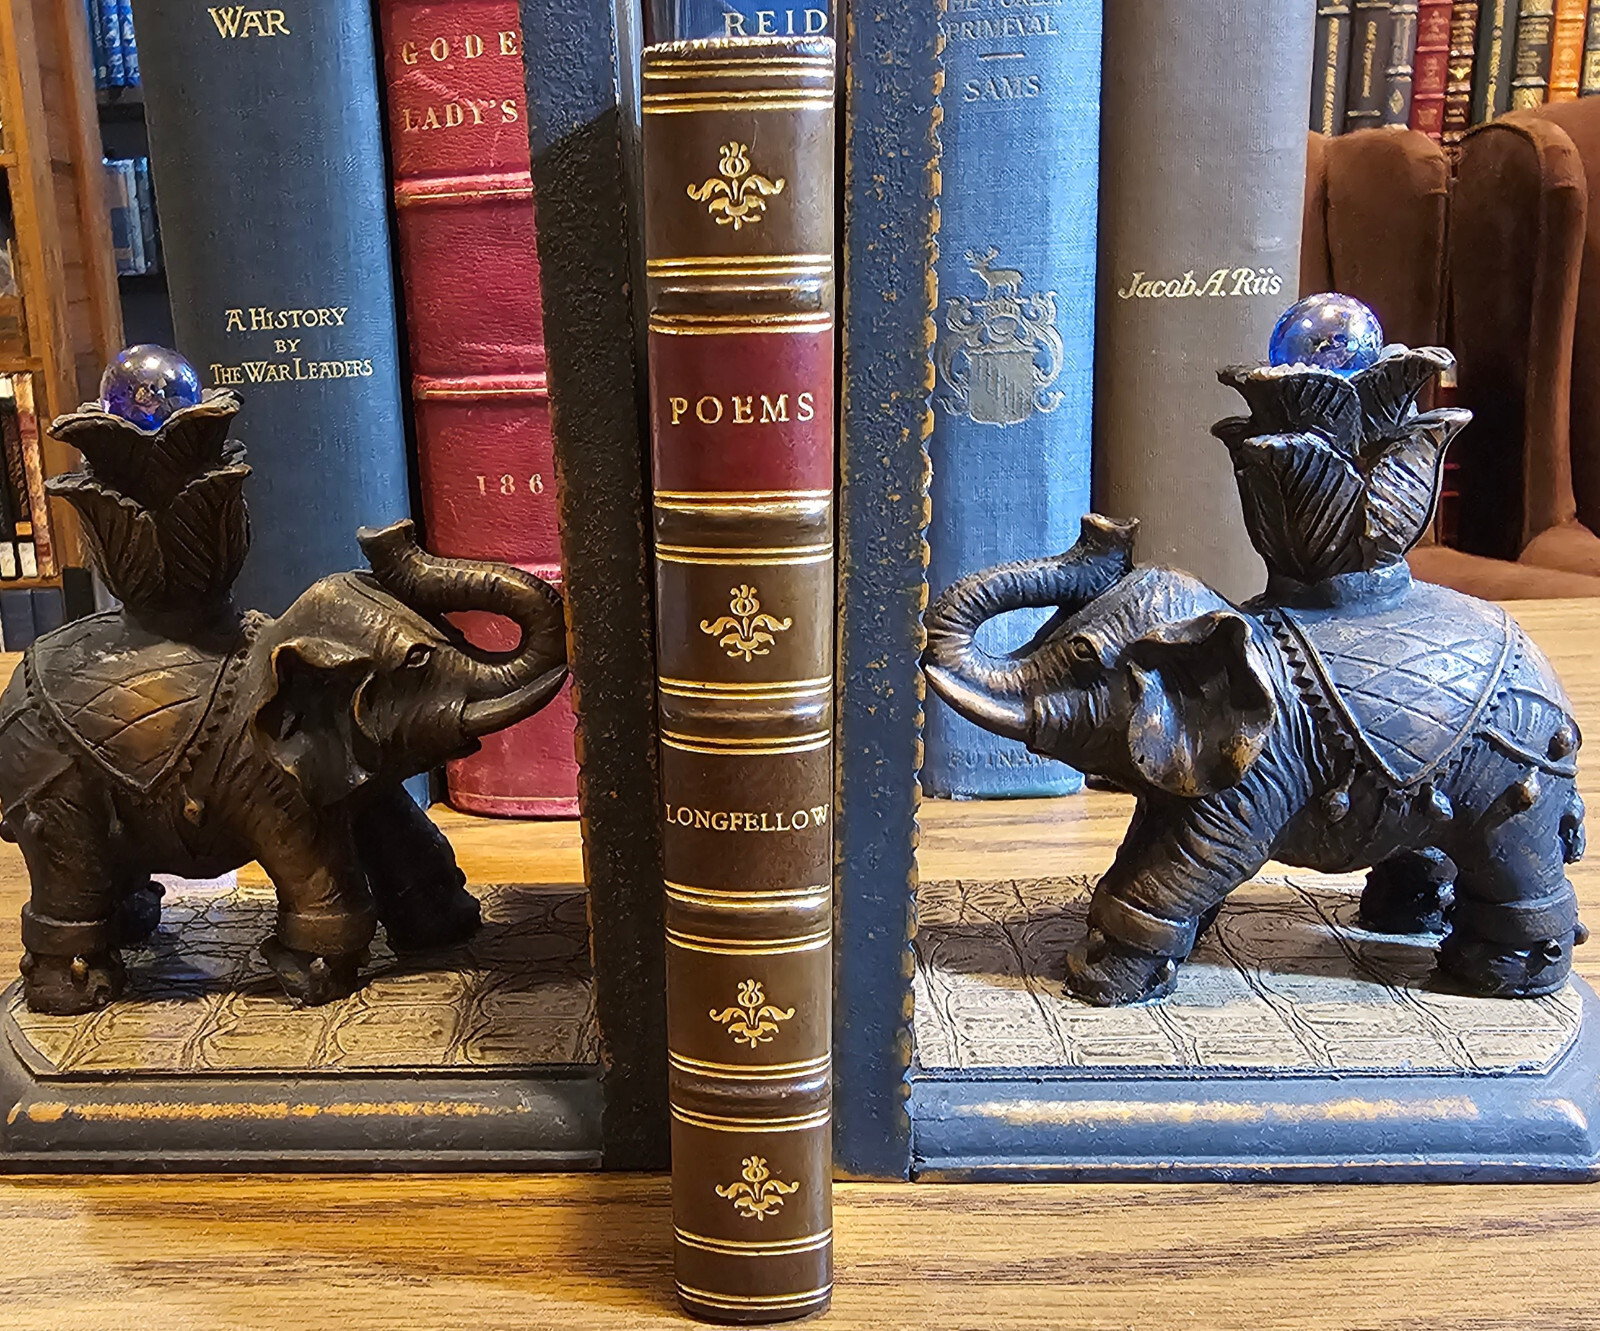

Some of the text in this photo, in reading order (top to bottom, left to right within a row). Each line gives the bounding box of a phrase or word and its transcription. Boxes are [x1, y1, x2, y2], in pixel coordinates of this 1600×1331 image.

[207, 5, 291, 39] WAR
[722, 9, 829, 37] REID
[946, 14, 1059, 42] PRIMEVAL
[401, 30, 518, 66] GODE
[963, 75, 1041, 102] SAMS
[402, 98, 519, 133] LADY'S
[1117, 266, 1284, 300] Jacob A. Riis
[225, 306, 349, 333] A HISTORY
[274, 338, 301, 353] BY
[209, 357, 375, 386] THE WAR LEADERS
[668, 391, 815, 426] POEMS
[476, 473, 544, 497] 186
[665, 802, 830, 832] LONGFELLOW
